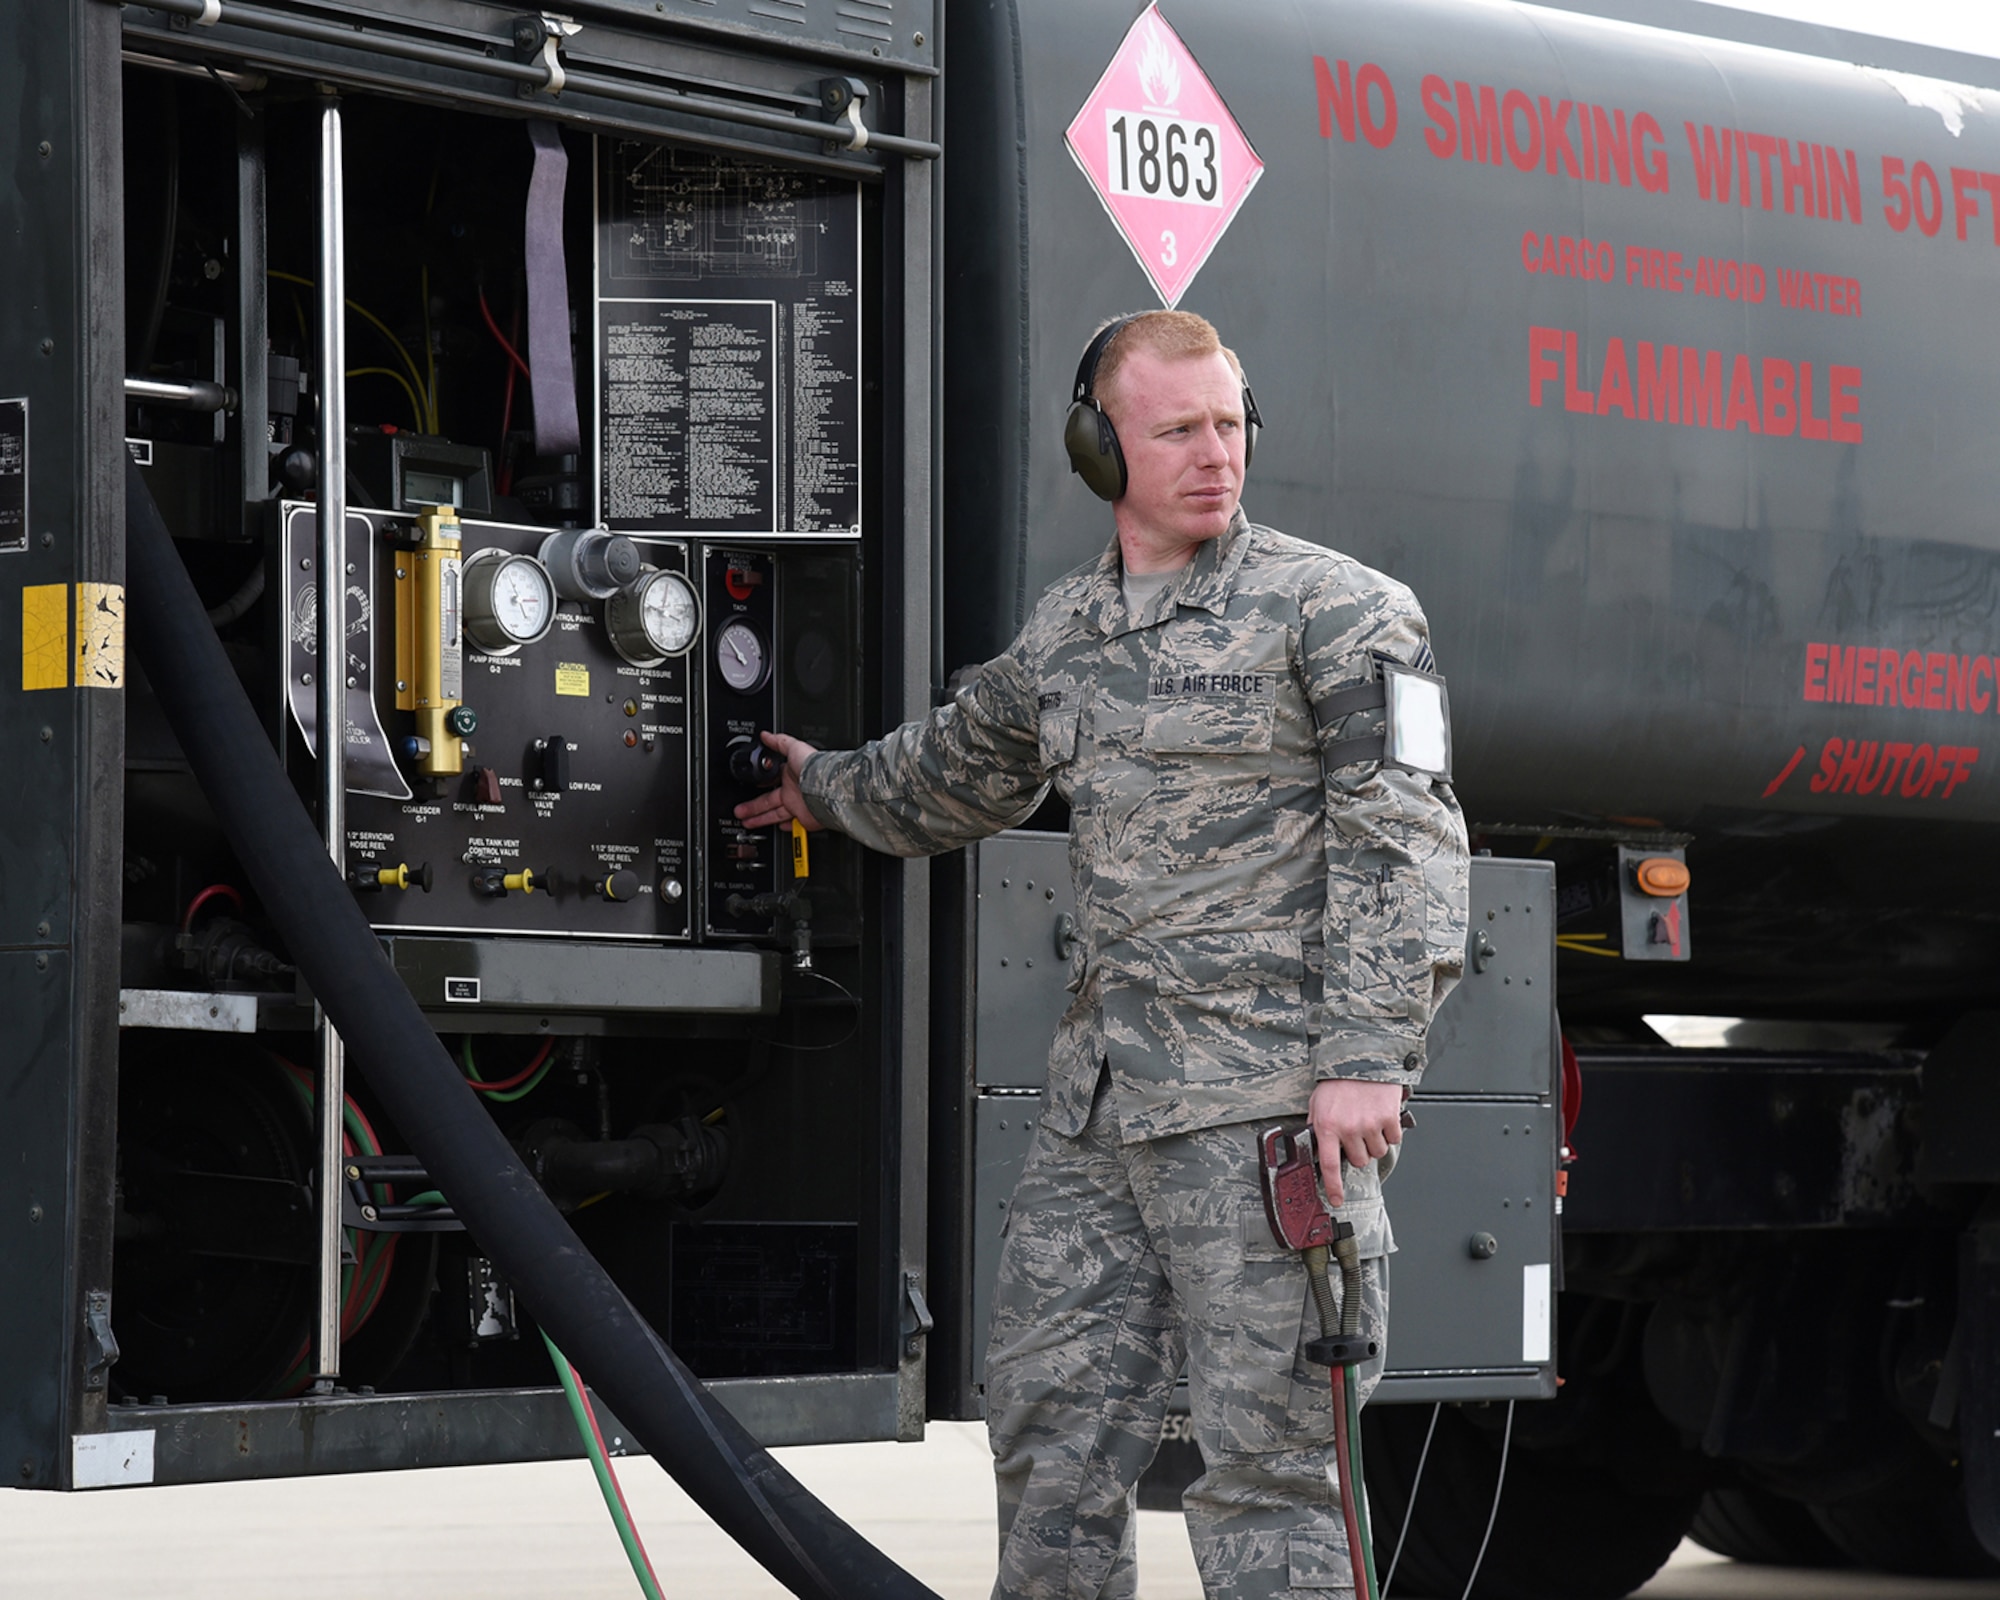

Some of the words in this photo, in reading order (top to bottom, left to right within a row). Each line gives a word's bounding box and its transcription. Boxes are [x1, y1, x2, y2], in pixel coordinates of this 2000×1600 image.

[1313, 56, 1398, 149] NO
[1421, 74, 1670, 193] SMOKING
[1685, 121, 1863, 225] WITHIN
[1882, 155, 1943, 237] 50
[1112, 116, 1218, 202] 1863
[1160, 229, 1178, 268] 3
[1522, 230, 1616, 283] CARGO
[1626, 246, 1767, 304] FIRE-AVOID
[1777, 267, 1862, 318] WATER
[1529, 326, 1863, 445] FLAMMABLE
[554, 612, 576, 622] NTROL
[561, 622, 580, 632] LIGHT
[469, 655, 487, 663] PUMP
[488, 656, 521, 667] PRESSURE
[617, 667, 640, 676] NOZZLE
[641, 668, 672, 679] PRESSURE
[1804, 642, 2000, 715] EMERGENC
[1154, 678, 1176, 696] U.S.
[1182, 675, 1206, 693] AIR
[1211, 674, 1263, 693] FORCE
[641, 693, 657, 702] TANK
[658, 695, 683, 704] SENSOR
[641, 702, 655, 710] DRY
[641, 724, 657, 732] TANK
[658, 725, 683, 734] SENSOR
[641, 733, 655, 741] WET
[1810, 737, 1980, 799] SHUTOFF
[499, 777, 524, 787] DEFUEL
[568, 782, 583, 791] LOW
[584, 782, 602, 791] FLOW
[528, 791, 561, 801] SELECTOR
[453, 802, 478, 812] DEFUEL
[478, 804, 506, 814] PRIMING
[534, 800, 554, 809] VALVE
[401, 805, 441, 815] COALESCER
[359, 831, 394, 841] SERVICING
[350, 840, 368, 849] HOSE
[369, 841, 387, 850] REEL
[468, 837, 485, 846] FUEL
[485, 838, 503, 847] TANK
[503, 839, 520, 848] VENT
[654, 838, 684, 848] DEADMAN
[468, 846, 499, 856] CONTROL
[499, 848, 520, 857] VALVE
[607, 844, 640, 855] SERVICING
[660, 848, 678, 856] HOSE
[598, 853, 615, 862] HOSE
[616, 854, 632, 863] REEL
[657, 855, 682, 865] REWIND
[638, 884, 654, 893] PEN
